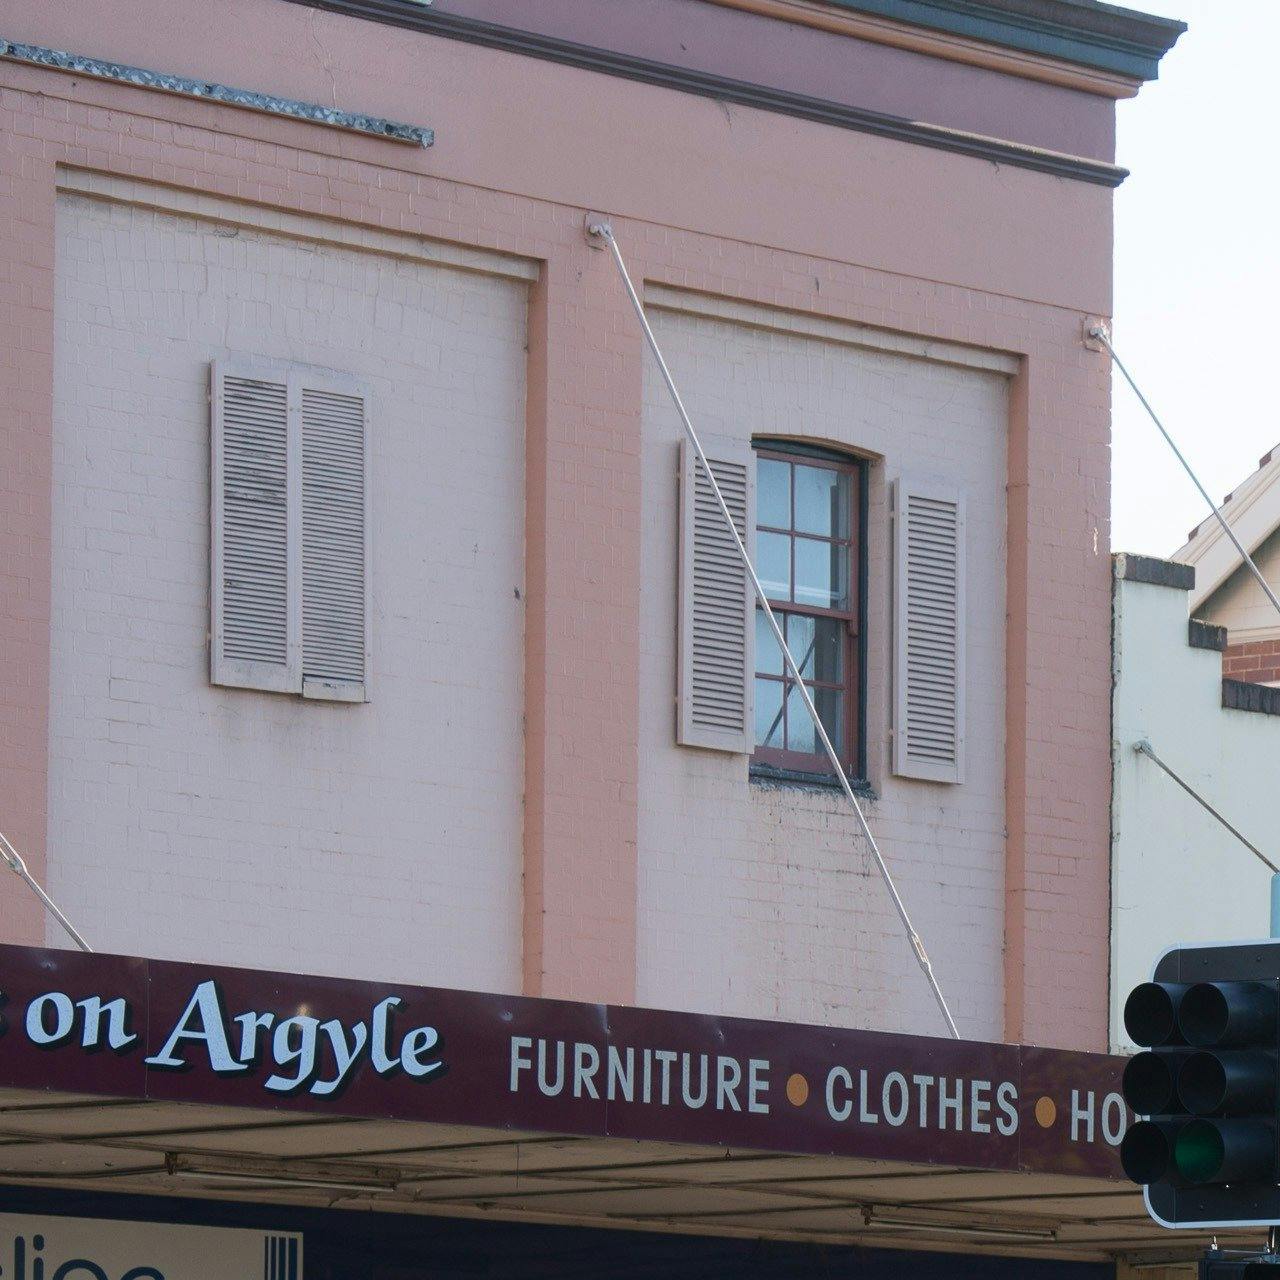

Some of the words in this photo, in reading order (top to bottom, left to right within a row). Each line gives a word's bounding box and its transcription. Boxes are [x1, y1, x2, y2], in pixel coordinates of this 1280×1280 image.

[26, 991, 137, 1049] on
[145, 980, 442, 1094] Argyle
[510, 1036, 770, 1114] FURNITURE
[825, 1065, 1019, 1136] CLOTHES
